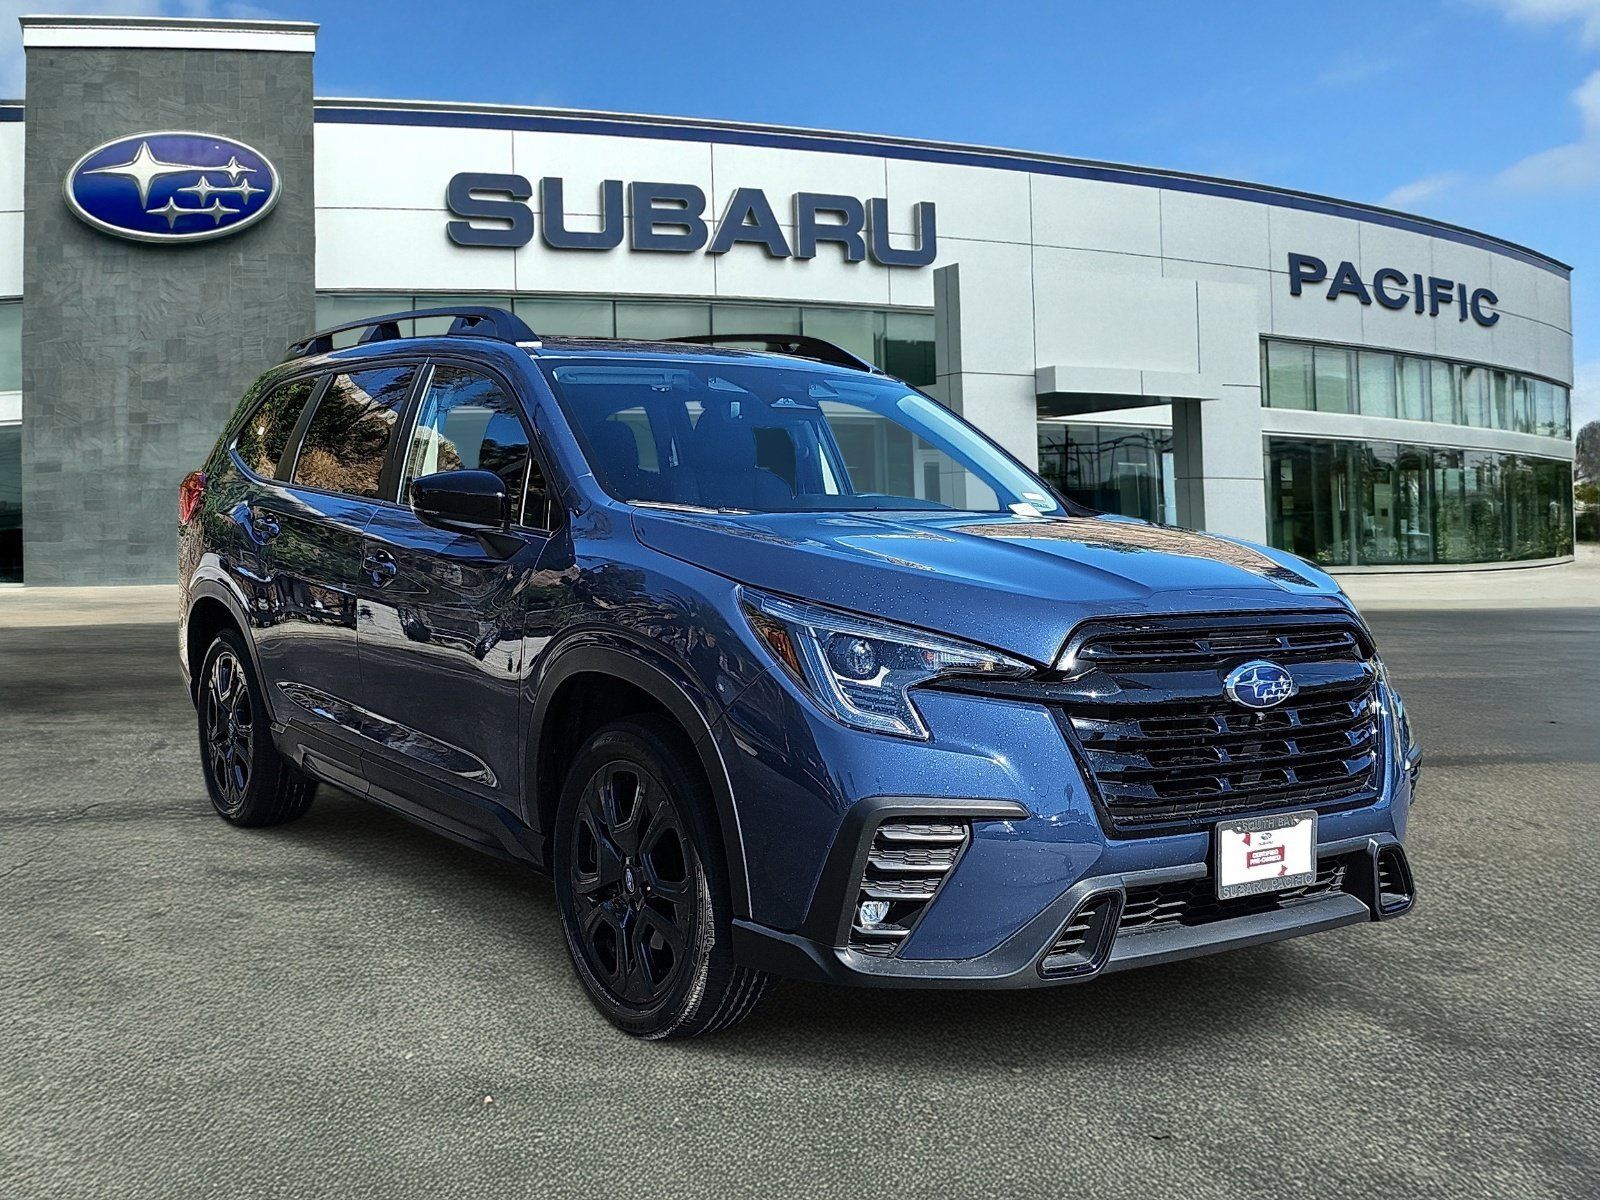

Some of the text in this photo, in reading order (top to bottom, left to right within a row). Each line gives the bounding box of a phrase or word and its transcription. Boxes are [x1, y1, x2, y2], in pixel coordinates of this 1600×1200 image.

[447, 171, 936, 268] SUBARU
[1287, 251, 1500, 327] PACIFIC
[1242, 819, 1276, 831] SOUTH
[1223, 874, 1313, 898] SUBARU PACIFIC
